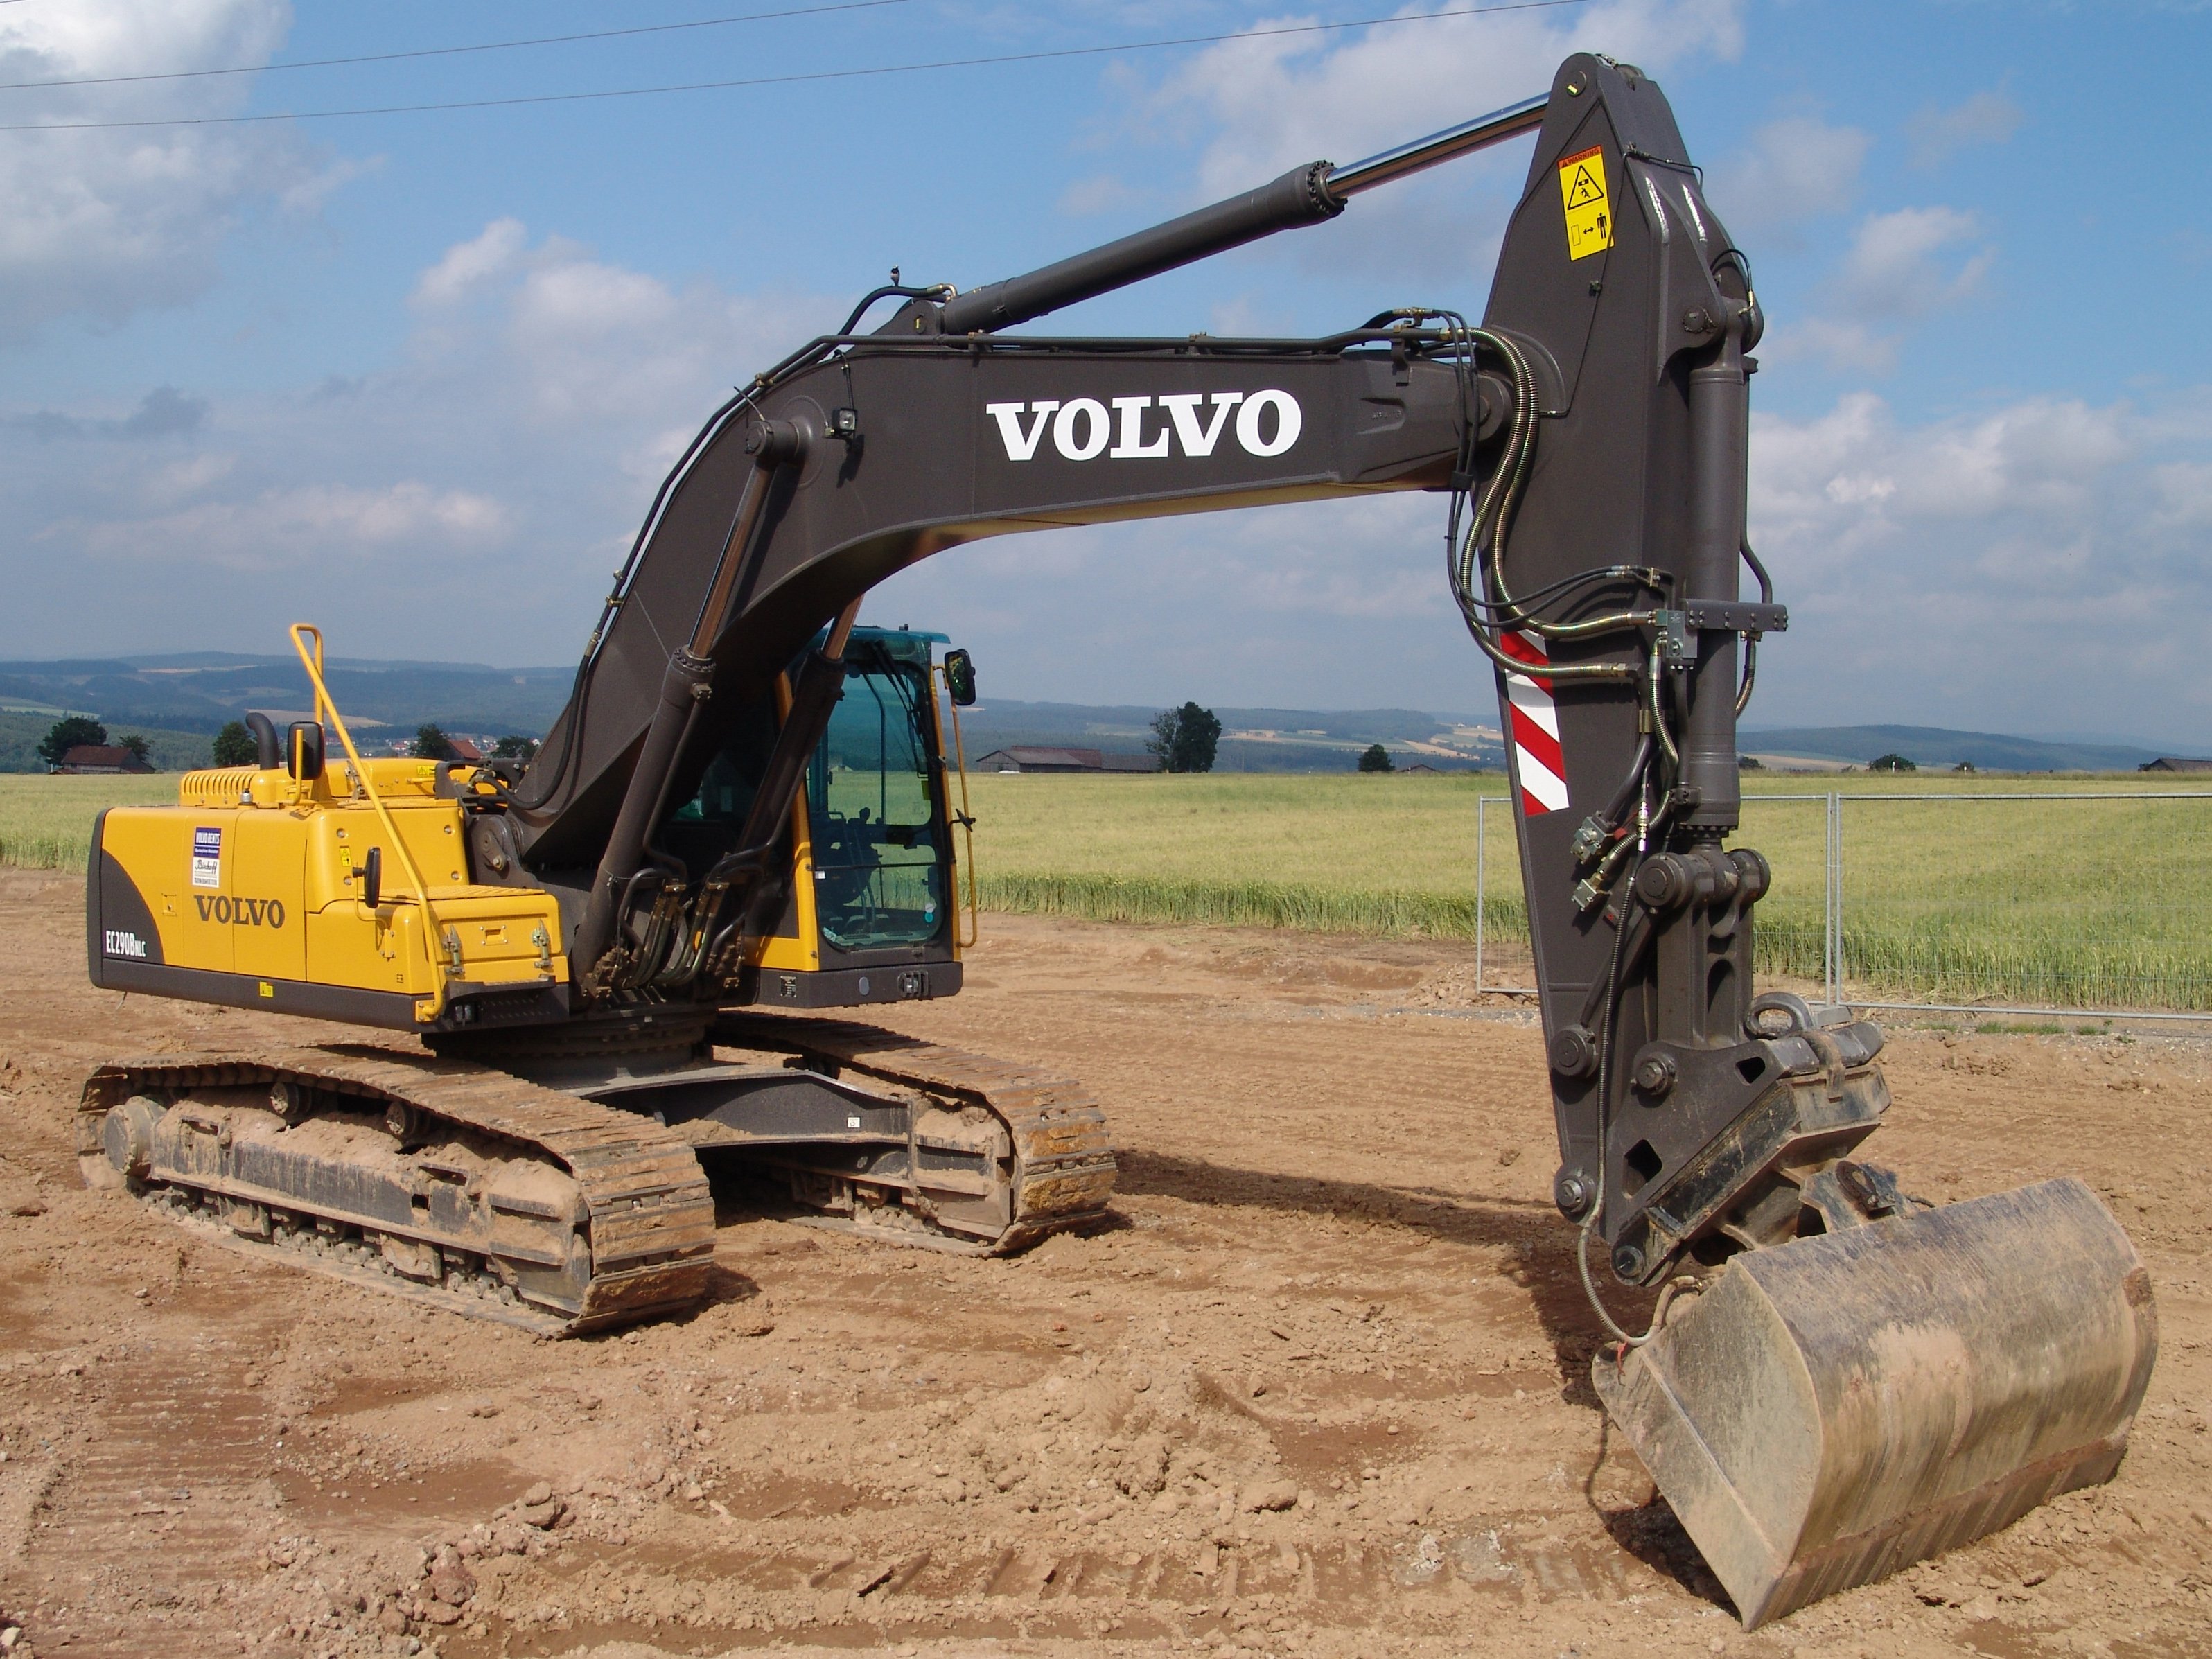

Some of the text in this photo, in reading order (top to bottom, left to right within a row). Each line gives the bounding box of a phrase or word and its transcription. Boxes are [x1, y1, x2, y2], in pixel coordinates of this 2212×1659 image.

[1568, 148, 1599, 164] WARNING
[986, 389, 1302, 461] VOLVO
[194, 895, 285, 929] VOLVO
